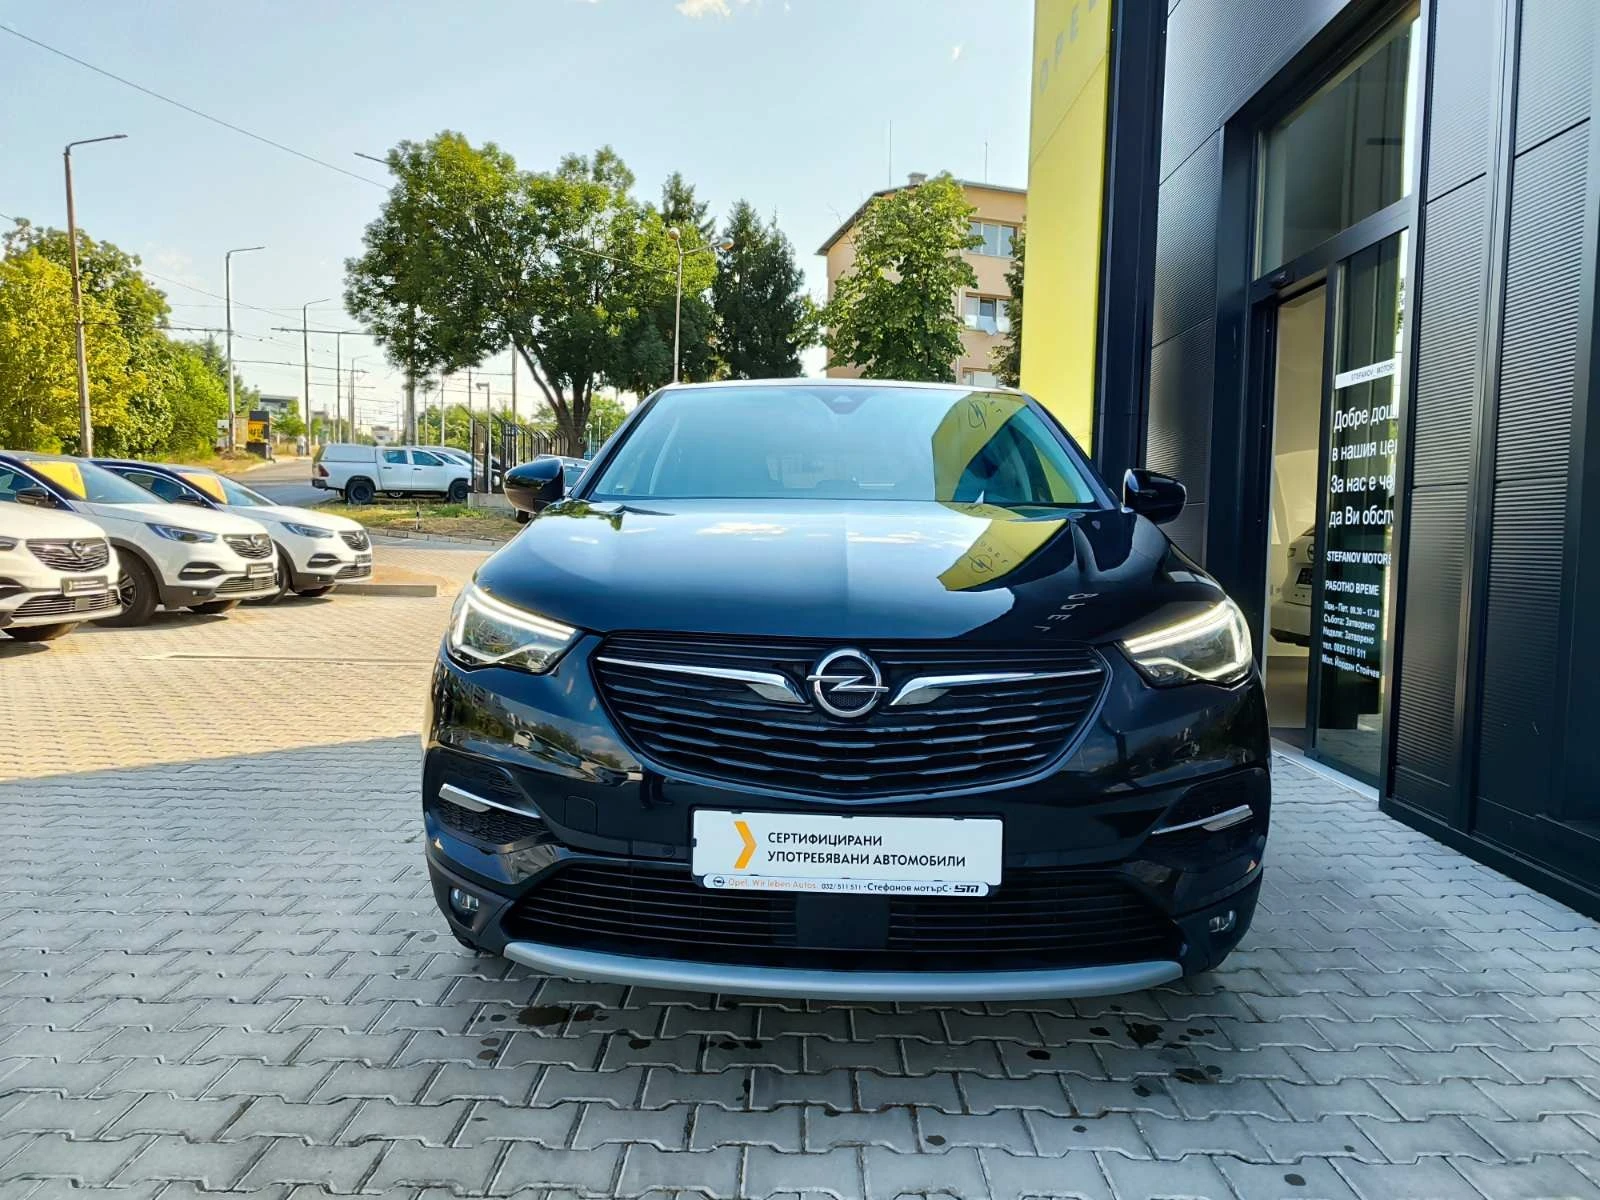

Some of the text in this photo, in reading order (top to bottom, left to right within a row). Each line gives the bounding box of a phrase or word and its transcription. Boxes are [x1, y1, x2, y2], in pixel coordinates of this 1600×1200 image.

[1334, 407, 1368, 433] Добре
[1332, 447, 1338, 461] в
[1341, 441, 1376, 460] нашия
[1331, 474, 1343, 493] За
[1346, 476, 1366, 492] нас
[1369, 476, 1376, 491] е
[1329, 511, 1342, 528] да
[1345, 506, 1359, 525] Ви
[1326, 551, 1361, 564] STEFANOV
[1325, 580, 1380, 596] РАБОТНО ВРЕМЕ
[767, 831, 883, 847] СЕРТИФИЦИРАНИ
[767, 850, 966, 867] УПОТРЕБЯВАНИ АВТОМОБИЛИ
[753, 879, 766, 887] Wir
[768, 879, 791, 888] leben
